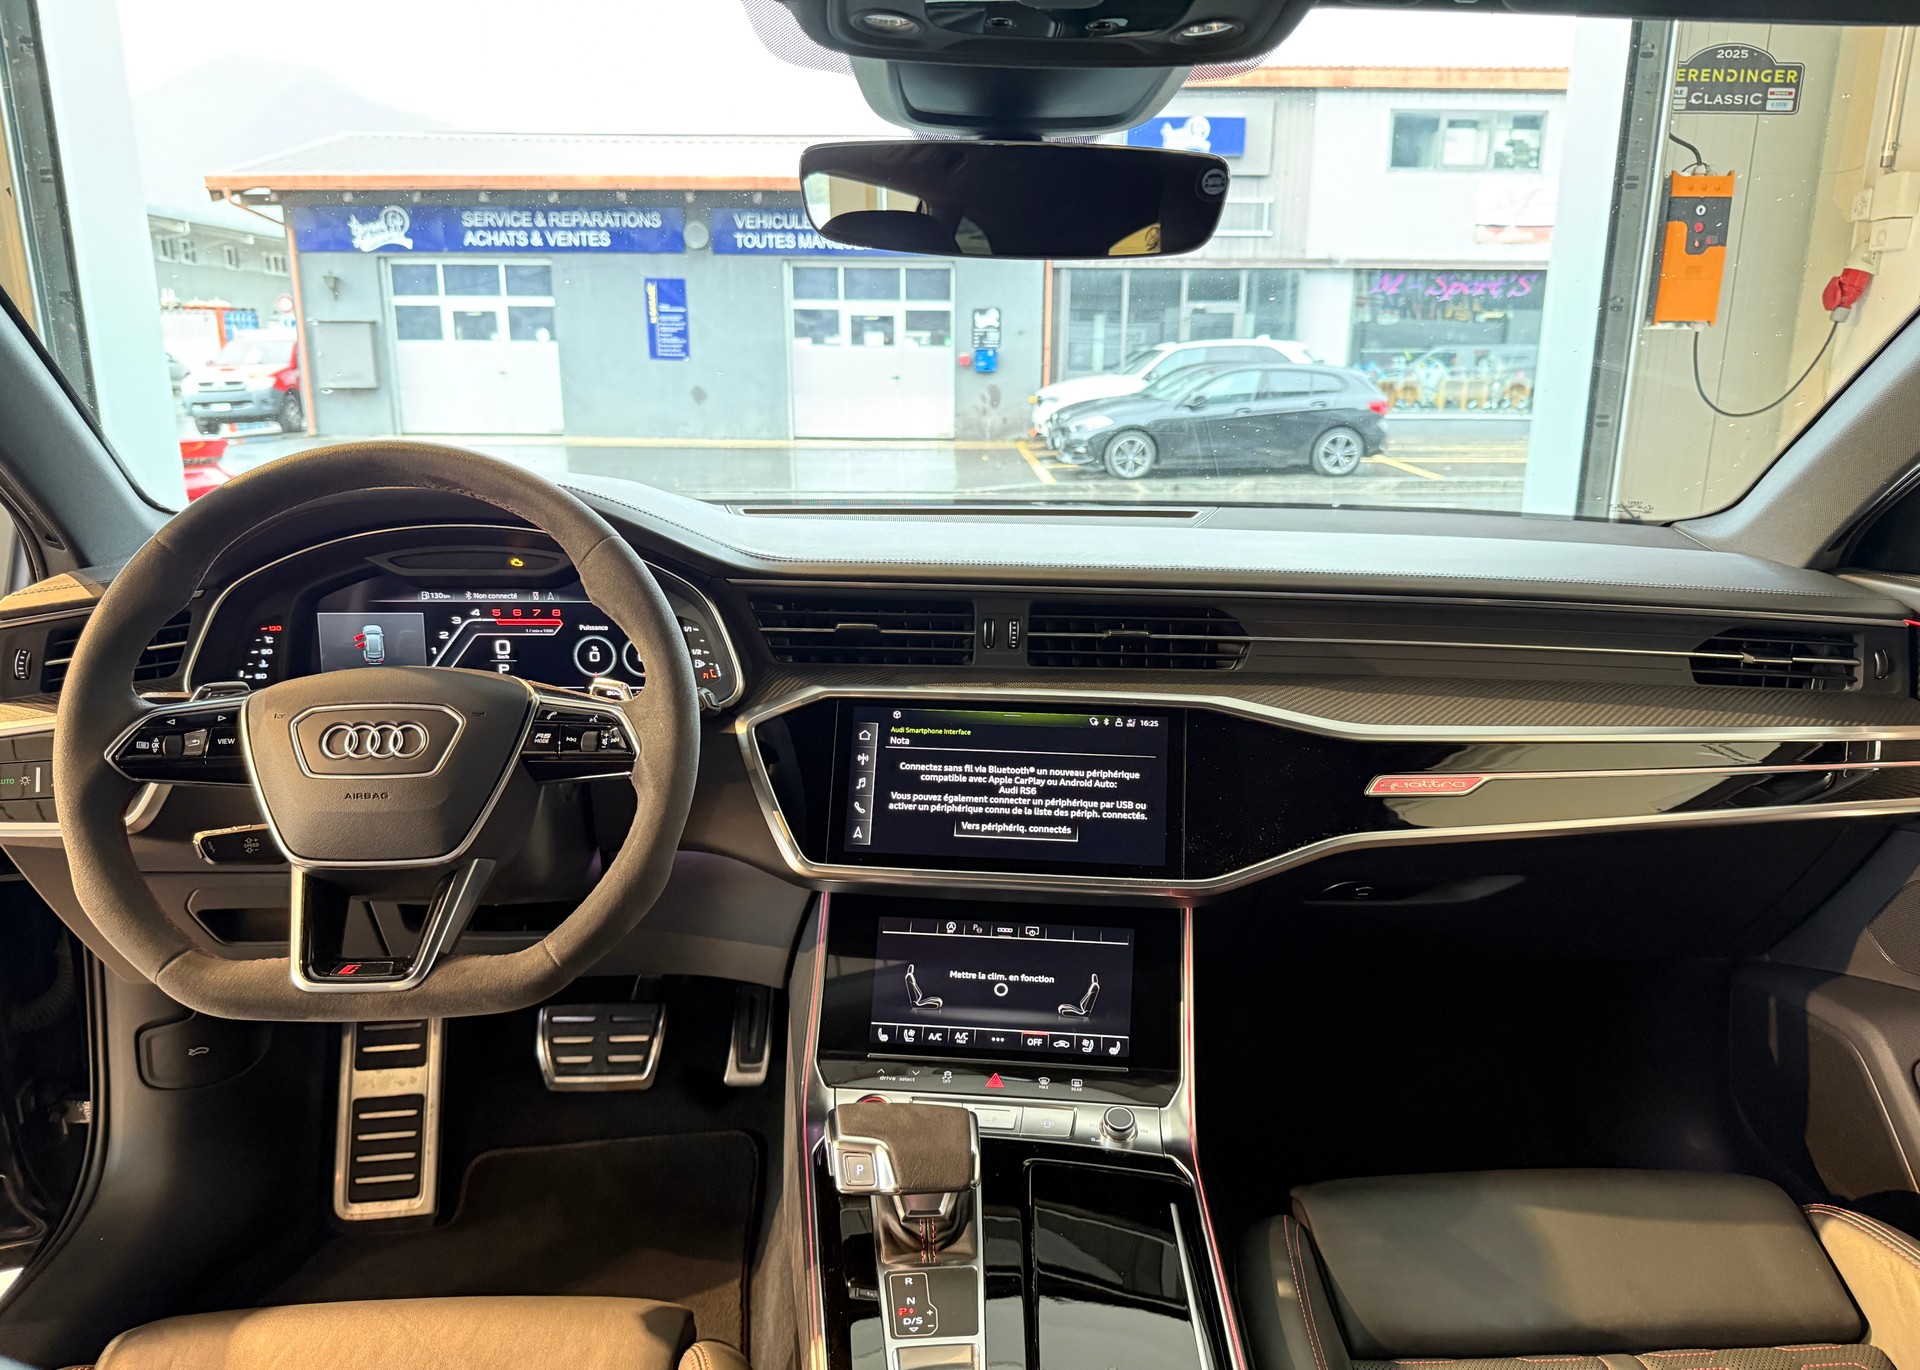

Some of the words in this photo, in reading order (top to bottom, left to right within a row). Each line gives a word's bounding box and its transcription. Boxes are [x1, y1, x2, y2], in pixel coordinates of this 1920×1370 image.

[1716, 50, 1749, 58] 2025
[1676, 68, 1798, 83] ERENDINGER
[1691, 92, 1763, 105] CLASSIC
[461, 211, 533, 227] SERVICE
[533, 211, 547, 227] &
[548, 211, 662, 228] REPARATIONS
[733, 213, 812, 229] VEHICULE
[464, 230, 530, 246] ACHATS
[530, 231, 544, 247] &
[545, 231, 612, 247] VENTES
[734, 233, 797, 249] TOUTES
[439, 631, 449, 639] 2
[495, 640, 511, 654] 0
[498, 664, 510, 674] P
[905, 727, 943, 735] Smartphone
[943, 728, 971, 736] Interface
[890, 736, 910, 745] Nota
[900, 762, 942, 772] Connectez
[944, 764, 962, 772] sans
[964, 764, 973, 773] fil
[974, 765, 986, 773] via
[1049, 769, 1084, 777] nouveau
[1086, 769, 1140, 780] périphérique
[920, 773, 967, 783] compatible
[988, 775, 1012, 785] Apple
[1014, 776, 1046, 787] CarPlay
[1059, 778, 1093, 787] Android
[1094, 779, 1117, 788] Auto:
[1380, 780, 1465, 791] quattro
[344, 792, 389, 800] AIRBAG
[999, 786, 1018, 794] Audi
[1020, 786, 1037, 795] RS6
[891, 791, 911, 800] Vous
[912, 793, 941, 802] pouvez
[943, 794, 988, 803] également
[1032, 798, 1043, 806] un
[1045, 798, 1098, 808] périphérique
[1100, 801, 1115, 809] par
[1116, 801, 1134, 809] USB
[888, 802, 916, 810] activer
[931, 803, 983, 814] périphérique
[1012, 806, 1022, 814] de
[1024, 807, 1032, 815] la
[1034, 807, 1052, 816] liste
[1054, 808, 1069, 817] des
[1070, 809, 1100, 819] périph.
[1102, 812, 1148, 820] connectés.
[961, 821, 980, 830] Vers
[981, 823, 1027, 834] périphériq.
[1028, 826, 1071, 834] connectés
[949, 970, 977, 979] Mettre
[978, 972, 986, 980] la
[987, 972, 1007, 981] clim.
[1020, 974, 1055, 983] fonction
[954, 1032, 969, 1040] A/C
[1027, 1038, 1043, 1046] OFF
[856, 1165, 864, 1175] P
[905, 1277, 913, 1286] R
[906, 1296, 916, 1305] N
[898, 1308, 907, 1317] P
[903, 1316, 923, 1326] D/S
